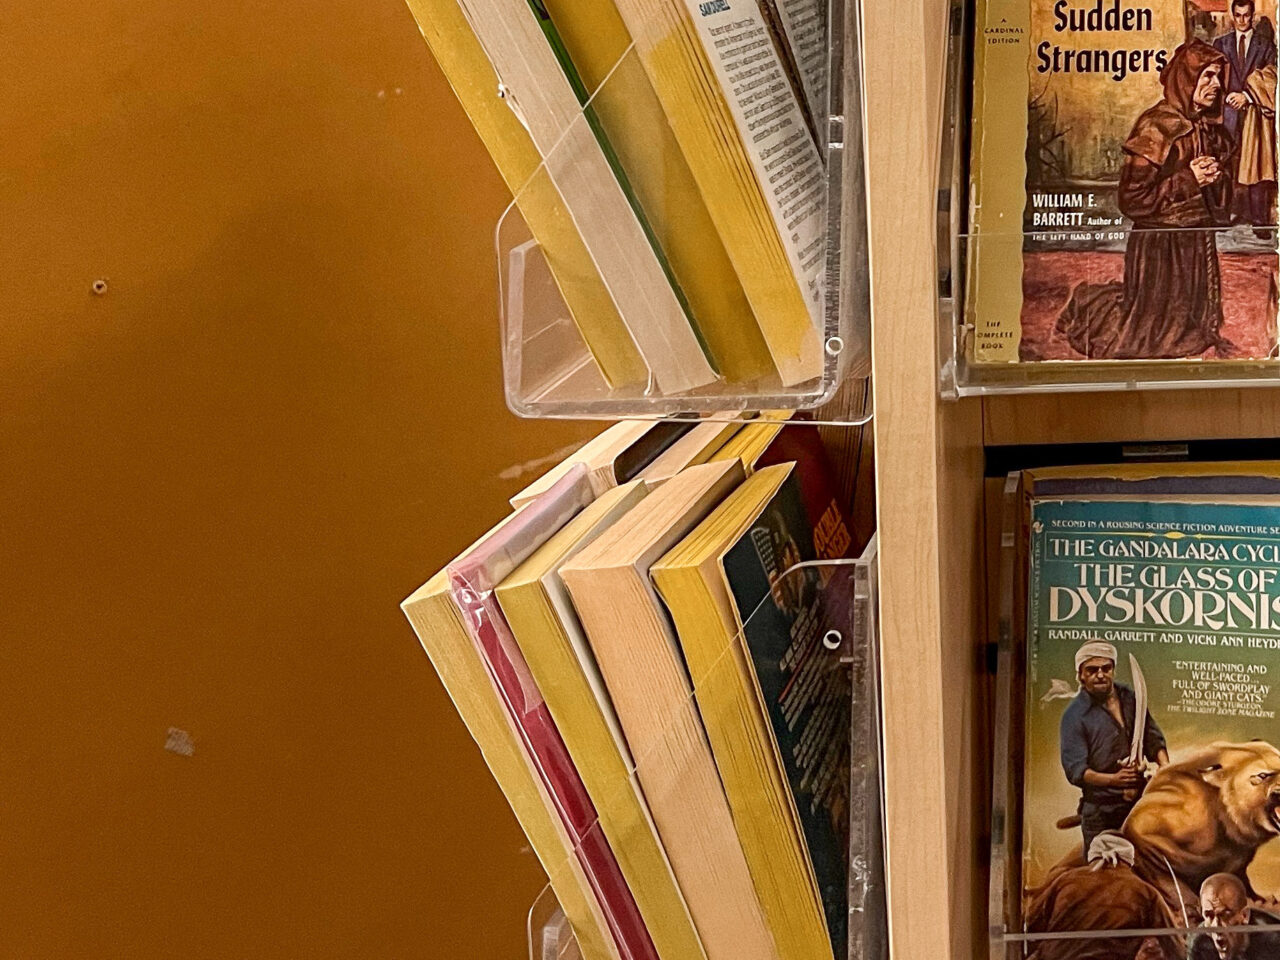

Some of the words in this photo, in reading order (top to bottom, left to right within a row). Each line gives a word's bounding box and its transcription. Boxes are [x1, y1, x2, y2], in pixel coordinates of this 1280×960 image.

[1054, 0, 1152, 32] Sudden
[1037, 41, 1168, 82] Strangers
[1032, 193, 1083, 208] WILLIAM
[1088, 193, 1098, 207] E.
[1033, 212, 1085, 226] BARRETT
[1087, 216, 1112, 225] Author
[1114, 216, 1123, 225] of
[1070, 232, 1092, 240] HAND
[1095, 232, 1105, 240] OF
[1108, 231, 1125, 240] GOD
[1051, 520, 1085, 528] SECOND
[1107, 521, 1144, 529] ROUSING
[1146, 522, 1182, 530] SCIENCE
[1183, 523, 1216, 532] FICTION
[1218, 524, 1267, 534] ADVENTURE
[1050, 538, 1095, 556] THE
[1098, 539, 1230, 561] GANDALARA
[1074, 563, 1136, 587] THE
[1139, 565, 1234, 591] GLASS
[1238, 568, 1277, 593] OF
[1048, 629, 1100, 640] RANDALL
[1104, 631, 1156, 642] GARRETT
[1159, 632, 1183, 643] AND
[1187, 634, 1216, 646] VICKI
[1220, 636, 1243, 647] ANN
[1247, 665, 1267, 674] AND
[1172, 680, 1195, 689] FULL
[1197, 681, 1211, 690] OF
[1212, 682, 1270, 694] SWORDPLAY
[1181, 690, 1202, 699] AND
[1204, 691, 1234, 701] GIANT
[1238, 709, 1275, 718] MAGAZINE
